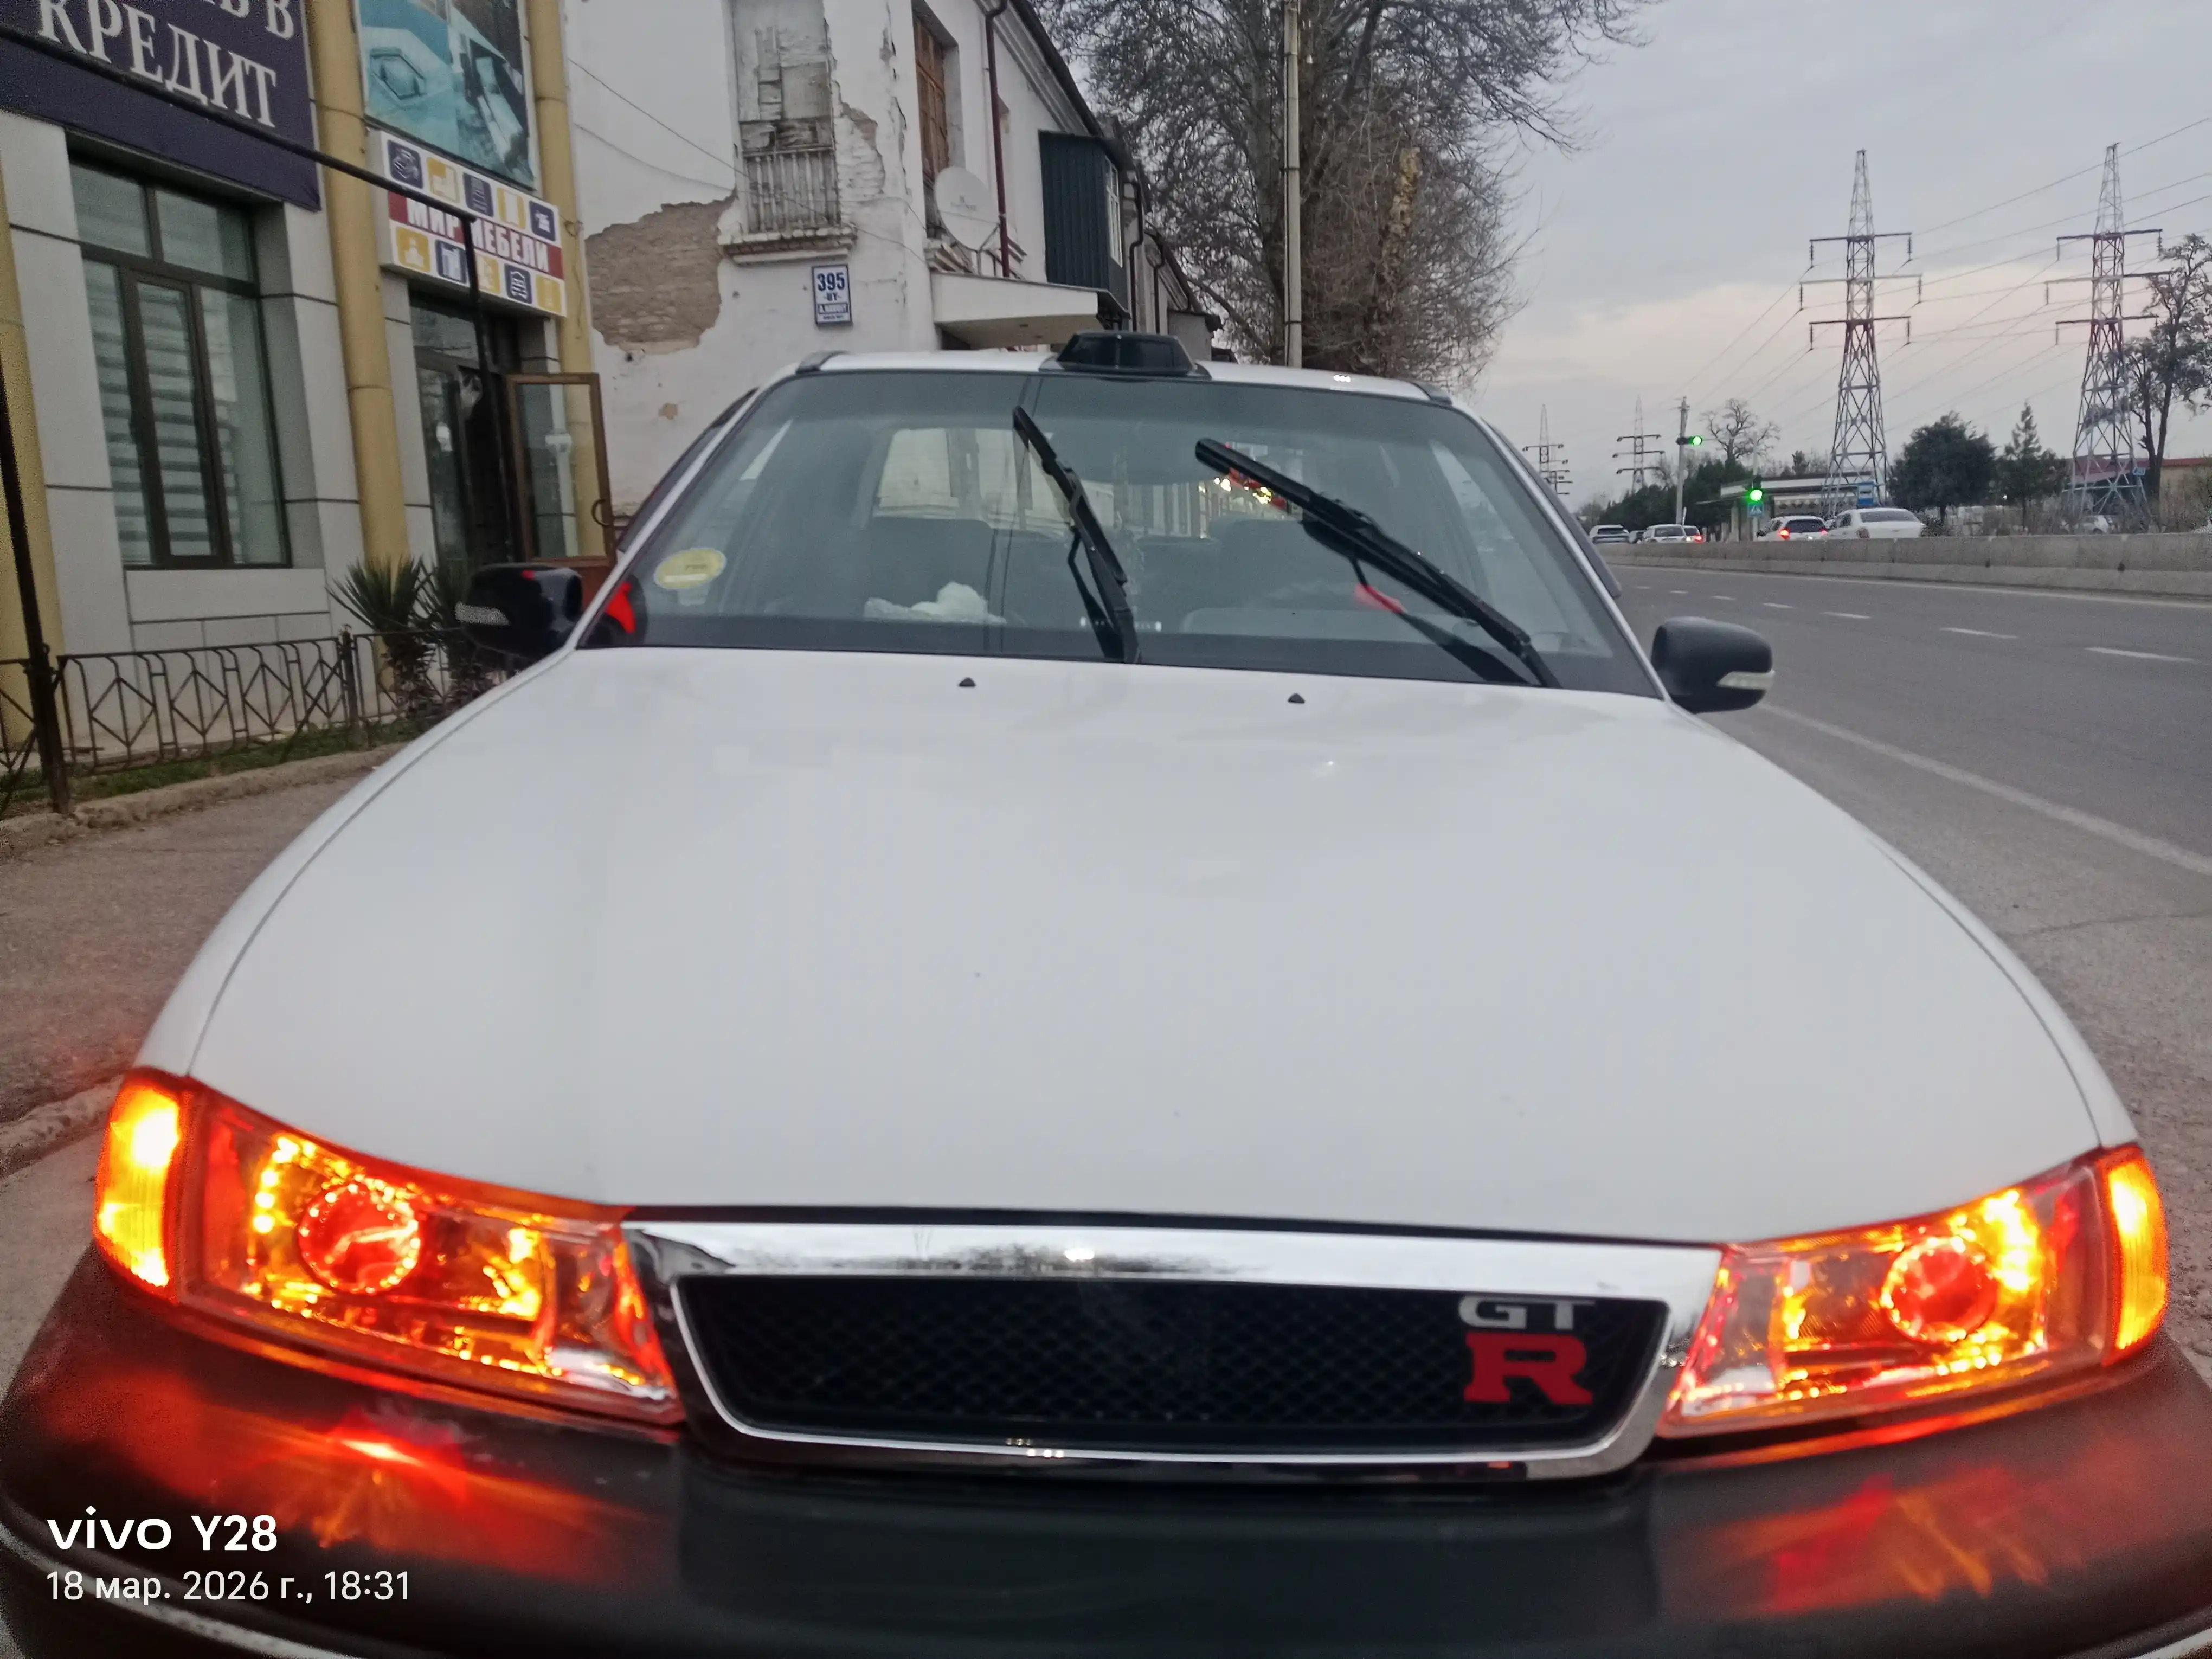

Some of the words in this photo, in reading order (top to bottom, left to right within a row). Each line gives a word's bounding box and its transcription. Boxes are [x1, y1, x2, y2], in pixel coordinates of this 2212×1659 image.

[406, 197, 461, 239] МИР
[817, 272, 845, 292] 395
[1458, 1296, 1596, 1330] GT
[1464, 1332, 1593, 1405] R
